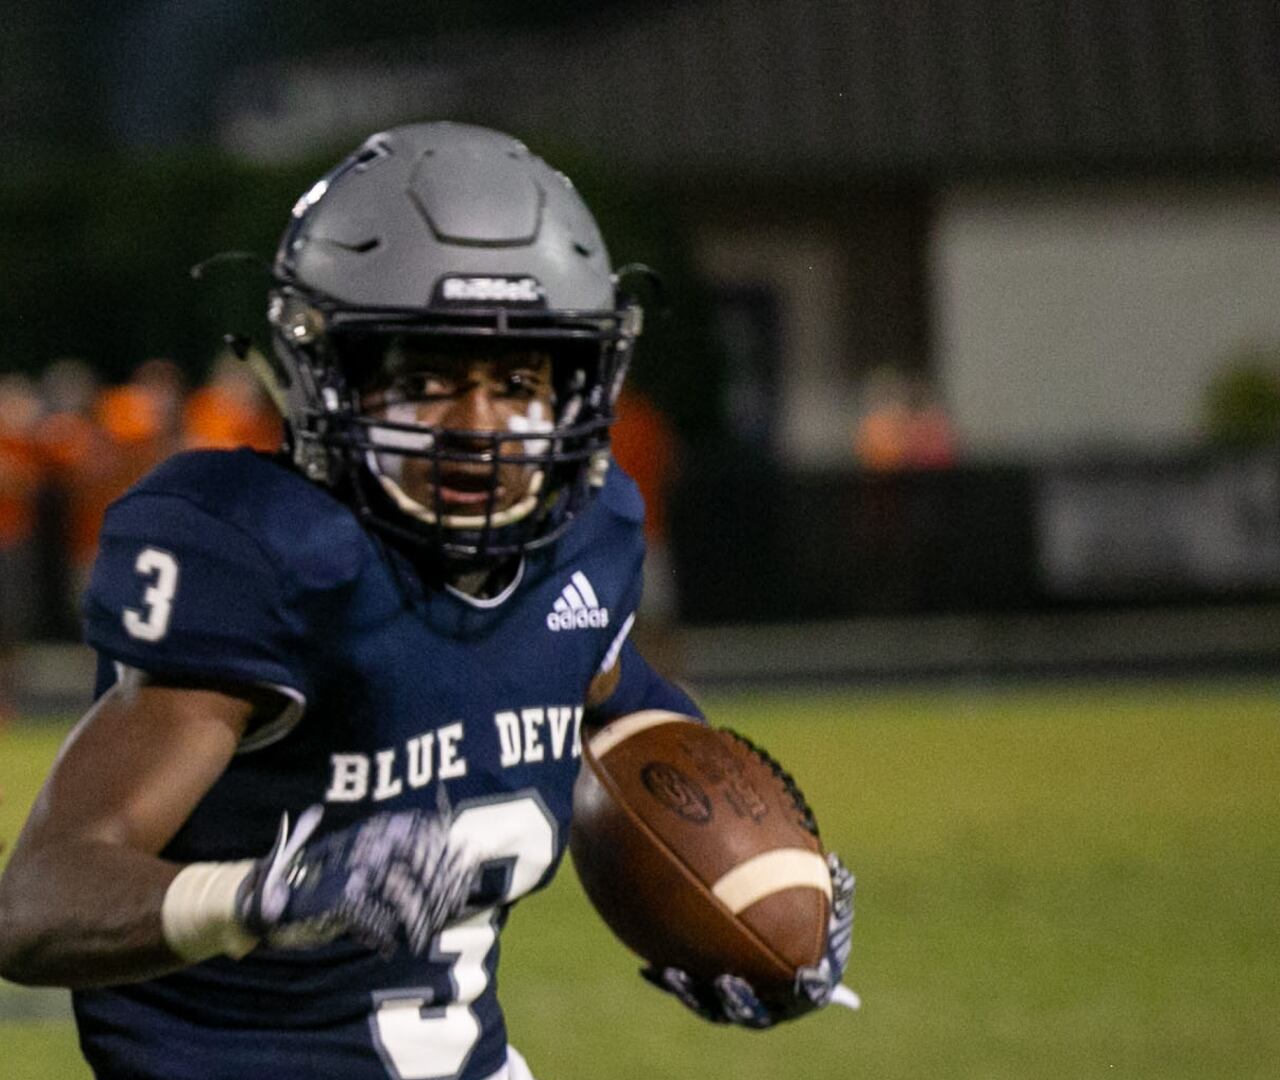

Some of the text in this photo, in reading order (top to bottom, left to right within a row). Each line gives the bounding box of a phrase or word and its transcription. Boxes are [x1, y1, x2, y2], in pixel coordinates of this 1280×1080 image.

[122, 546, 179, 642] 3
[546, 607, 609, 632] adidas
[325, 720, 468, 802] BLUE
